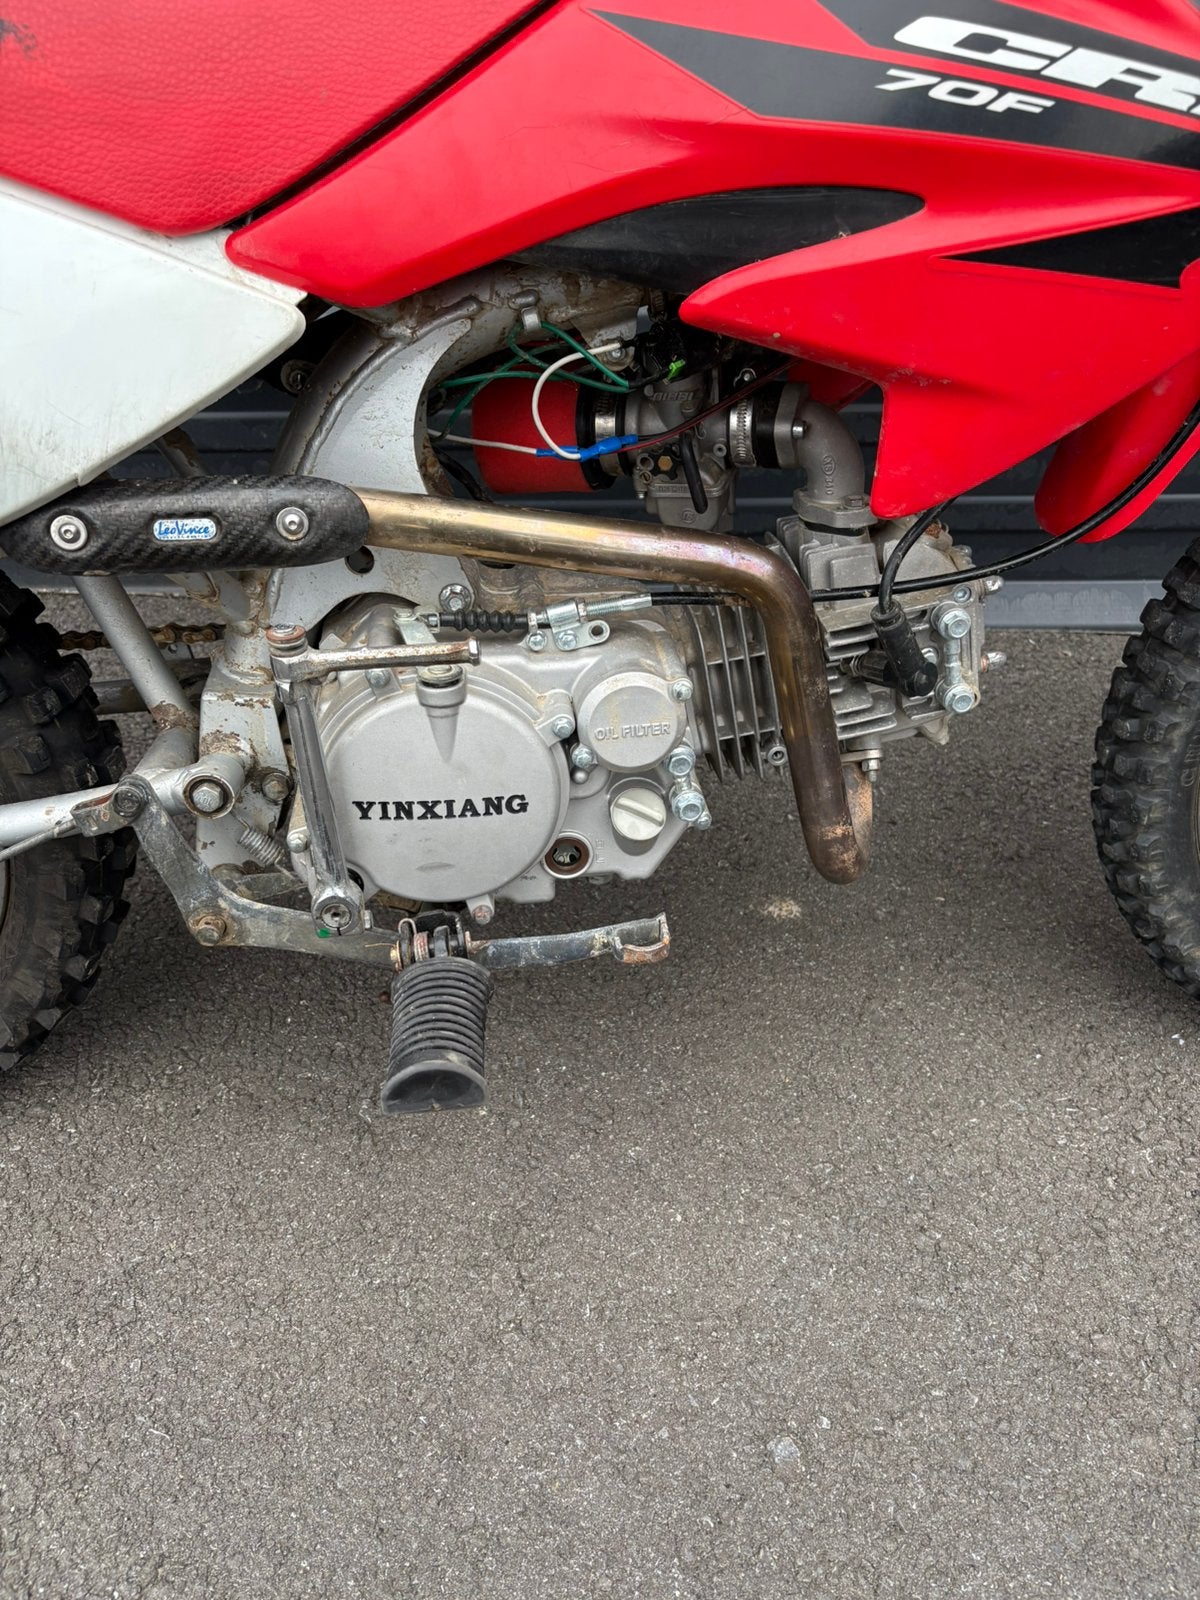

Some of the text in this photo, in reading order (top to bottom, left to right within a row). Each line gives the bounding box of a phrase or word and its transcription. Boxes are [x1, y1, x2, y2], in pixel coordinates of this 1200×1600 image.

[893, 16, 1200, 115] CR
[874, 68, 1056, 114] 70F
[158, 520, 210, 536] LeoVince
[594, 722, 671, 741] OIL FILTER
[352, 794, 530, 821] YINXIANG
